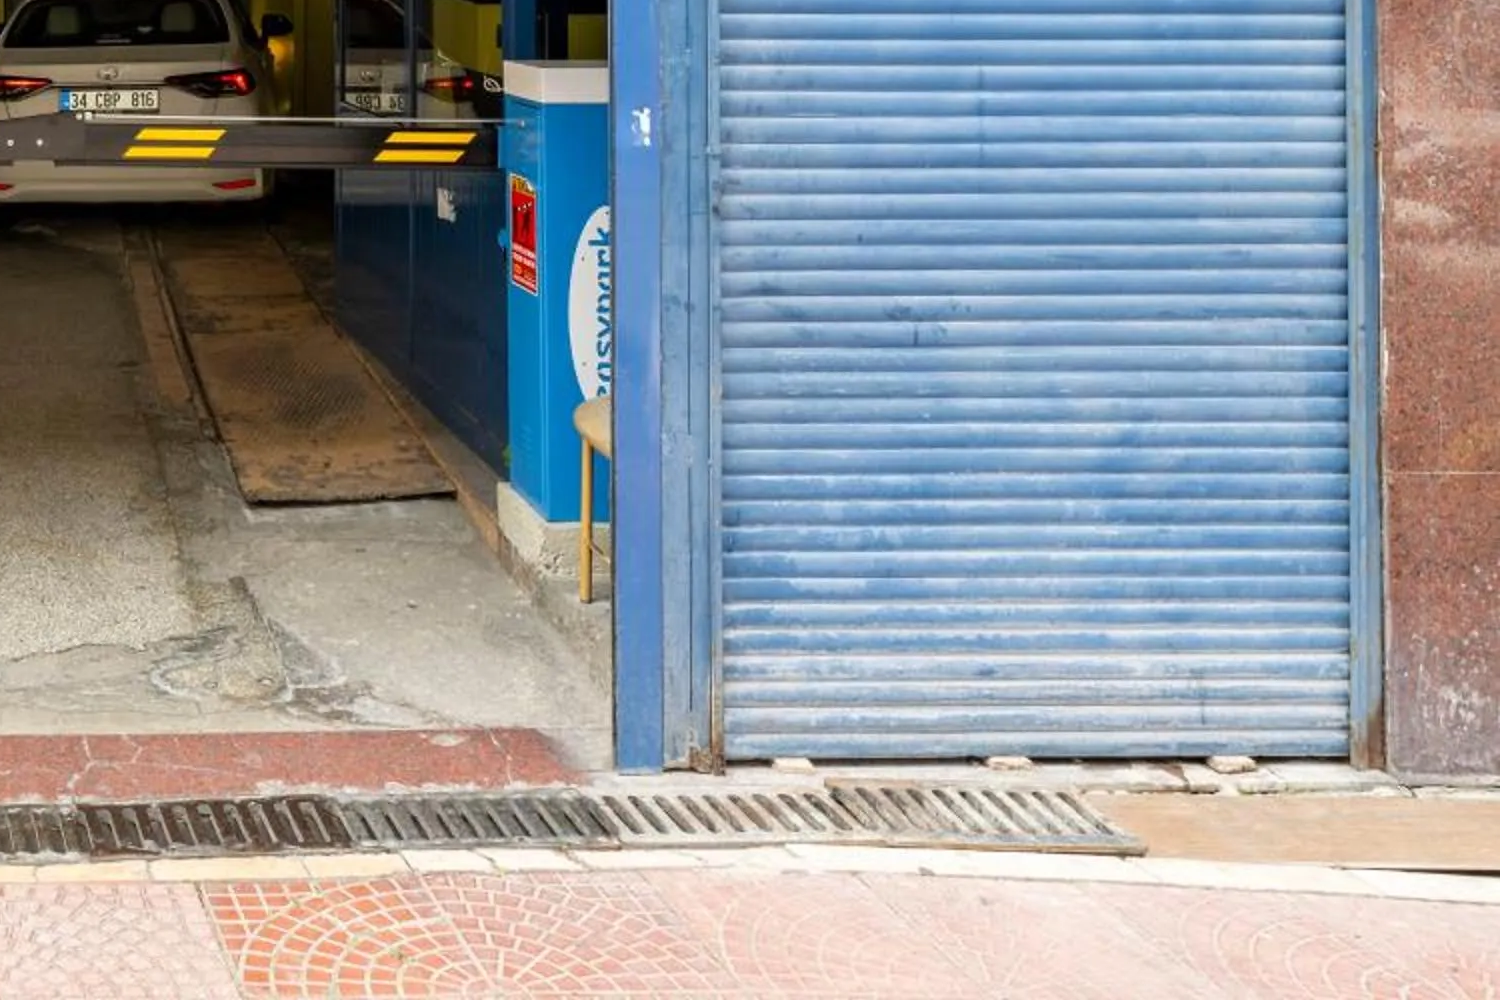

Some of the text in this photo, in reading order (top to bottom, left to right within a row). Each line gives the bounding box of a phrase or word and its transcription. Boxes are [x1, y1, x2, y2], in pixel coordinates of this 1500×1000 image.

[70, 91, 155, 109] 34 CBP 816
